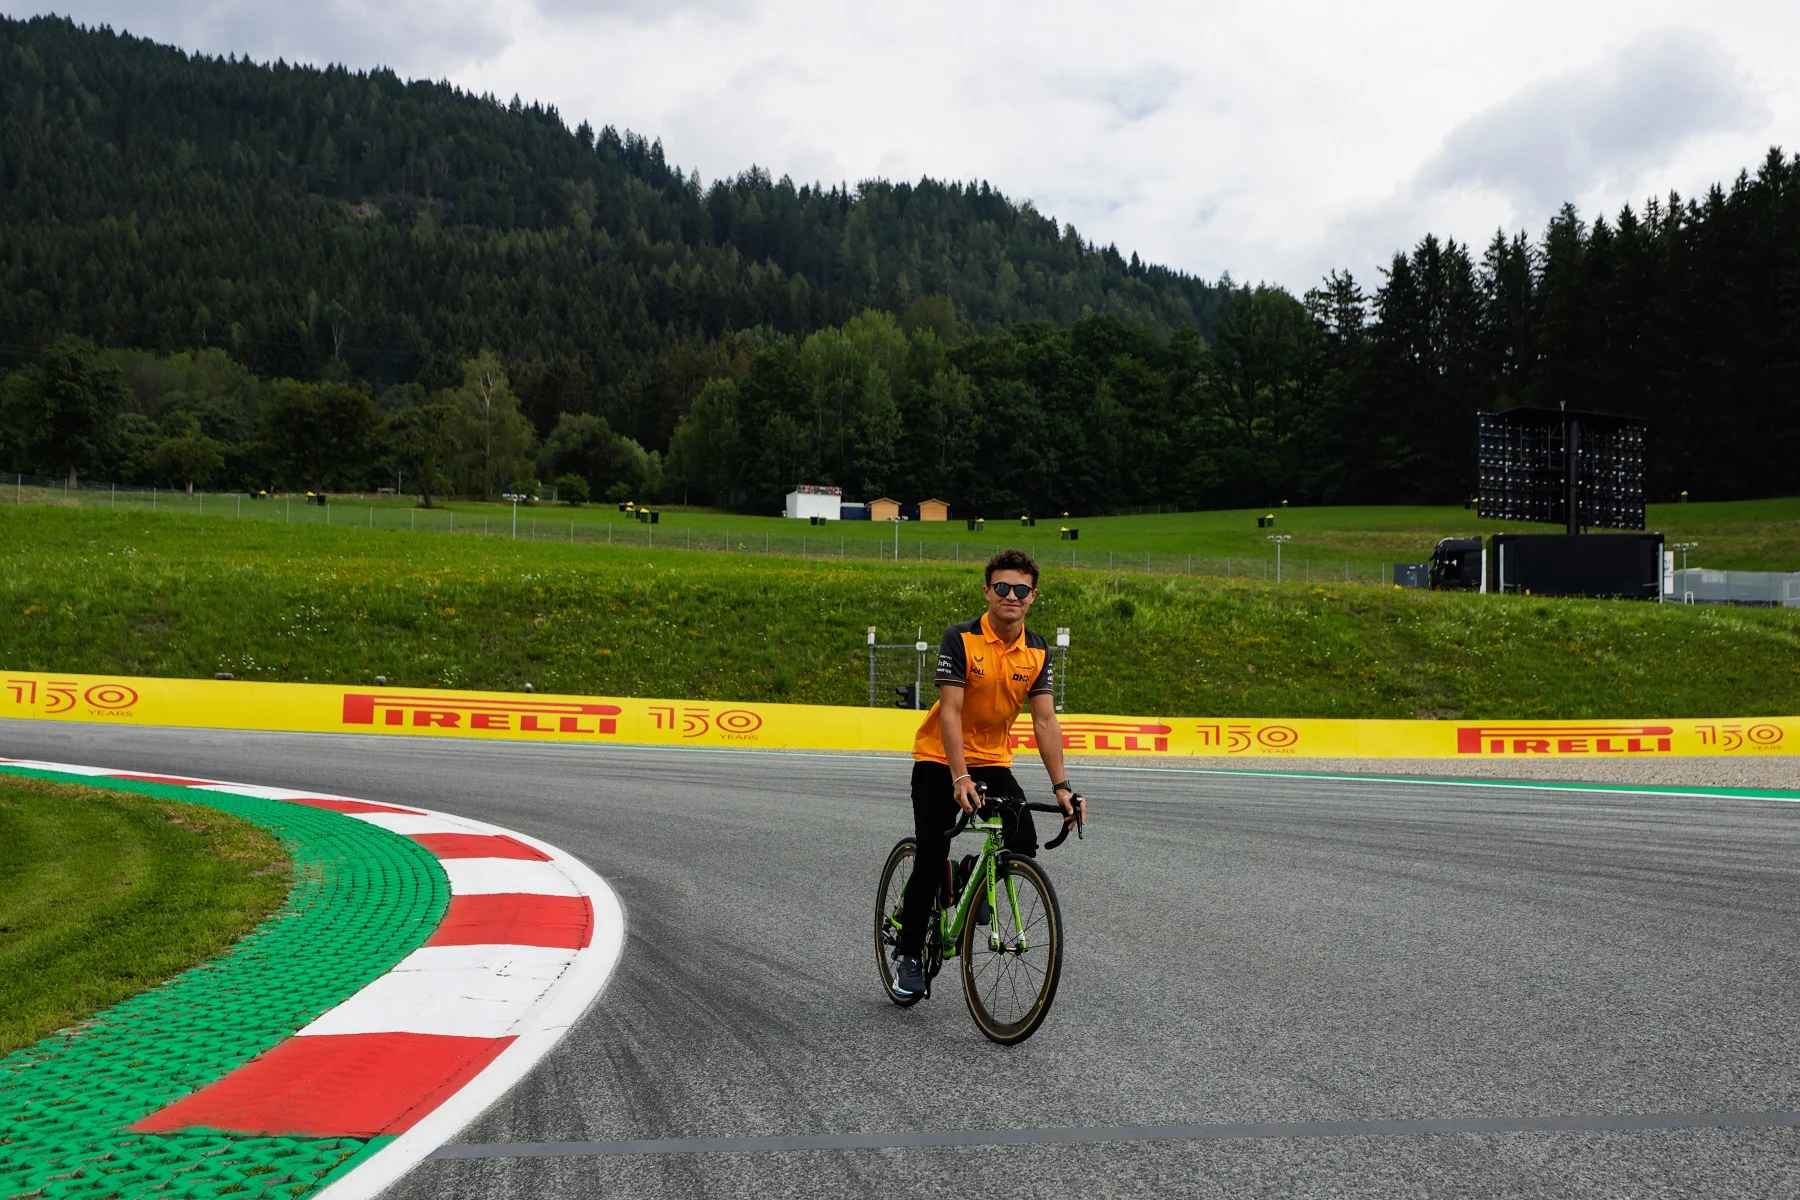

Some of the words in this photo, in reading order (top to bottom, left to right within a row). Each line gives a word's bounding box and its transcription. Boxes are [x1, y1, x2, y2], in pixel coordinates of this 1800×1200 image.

[7, 679, 139, 714] 150
[88, 709, 133, 717] YEARS
[341, 693, 623, 735] PIRELLI
[649, 705, 763, 738] 150
[720, 733, 759, 741] YEARS
[1009, 721, 1173, 752] RELLI
[1196, 724, 1299, 753] 150
[1456, 725, 1675, 755] PIRELLI
[1695, 724, 1784, 752] 150
